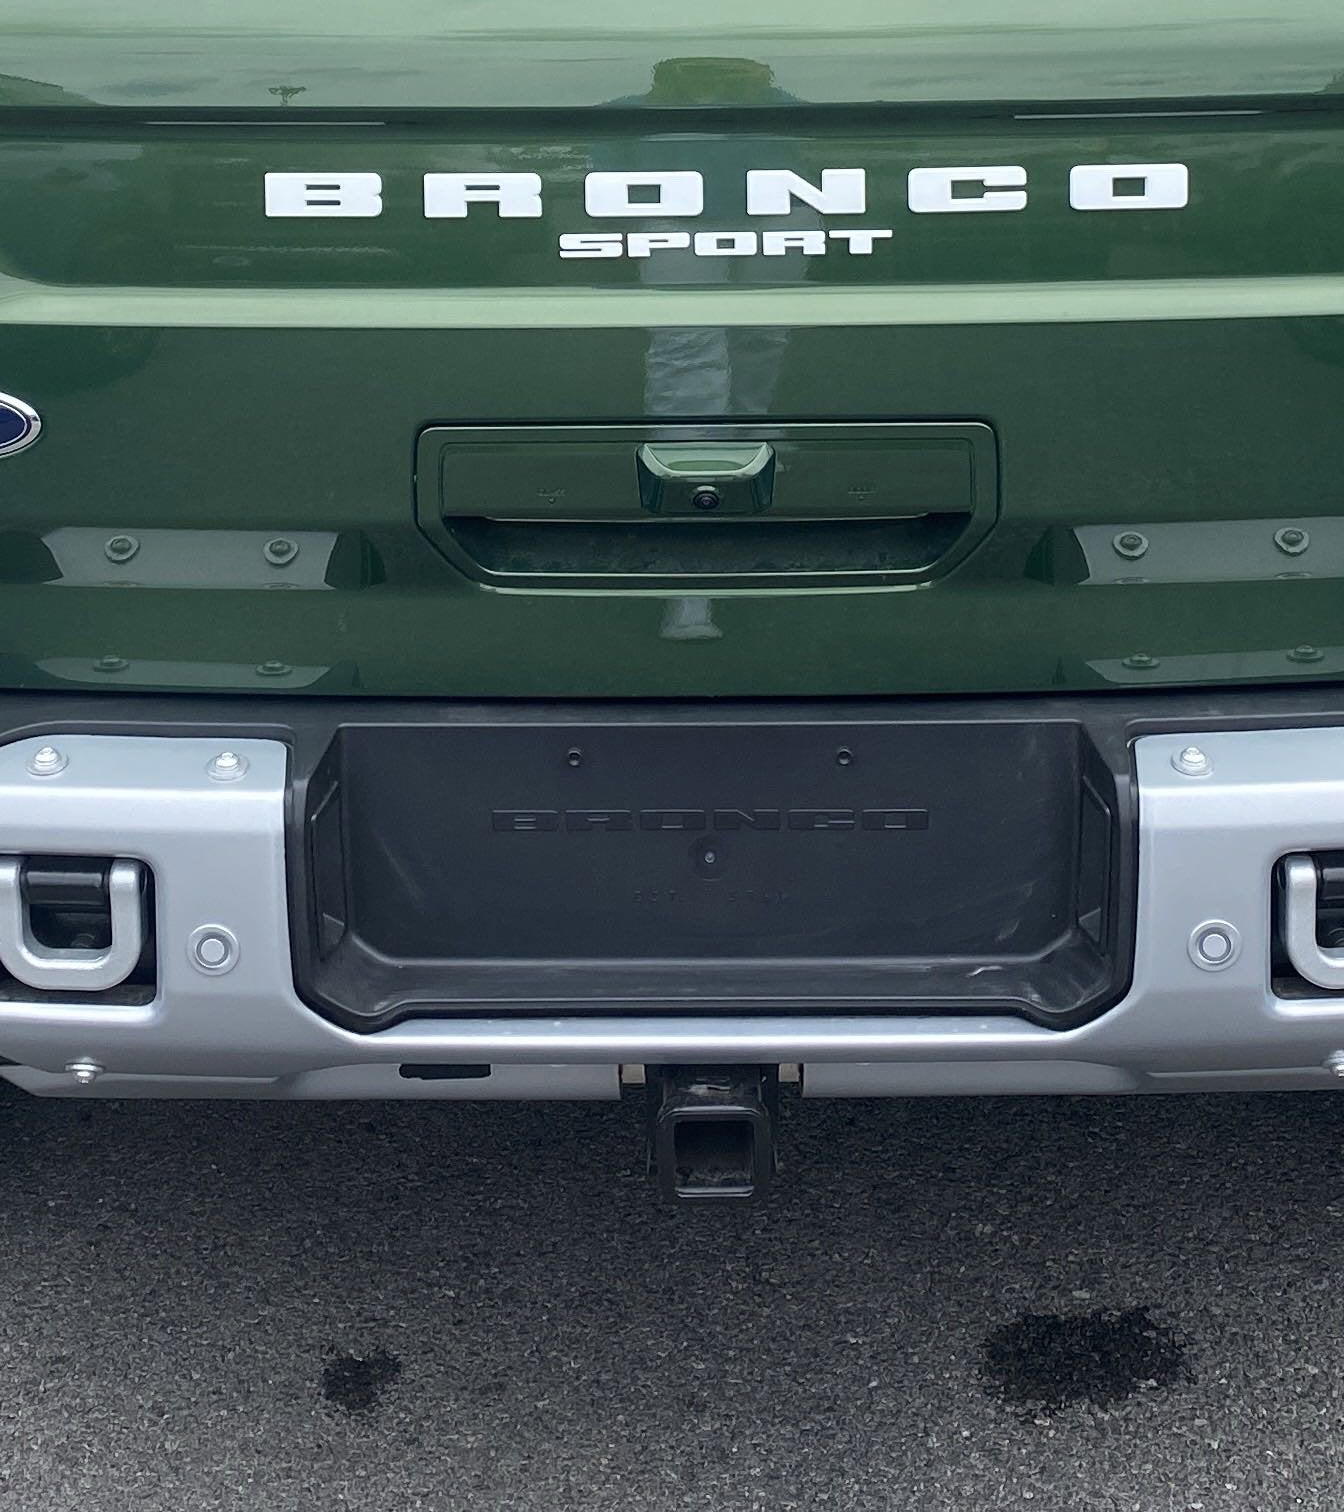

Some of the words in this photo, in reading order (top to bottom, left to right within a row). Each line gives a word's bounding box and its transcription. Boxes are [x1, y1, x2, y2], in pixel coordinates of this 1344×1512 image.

[263, 163, 1189, 218] BRONCO
[559, 228, 893, 259] SPORT
[492, 809, 929, 831] BRONCO
